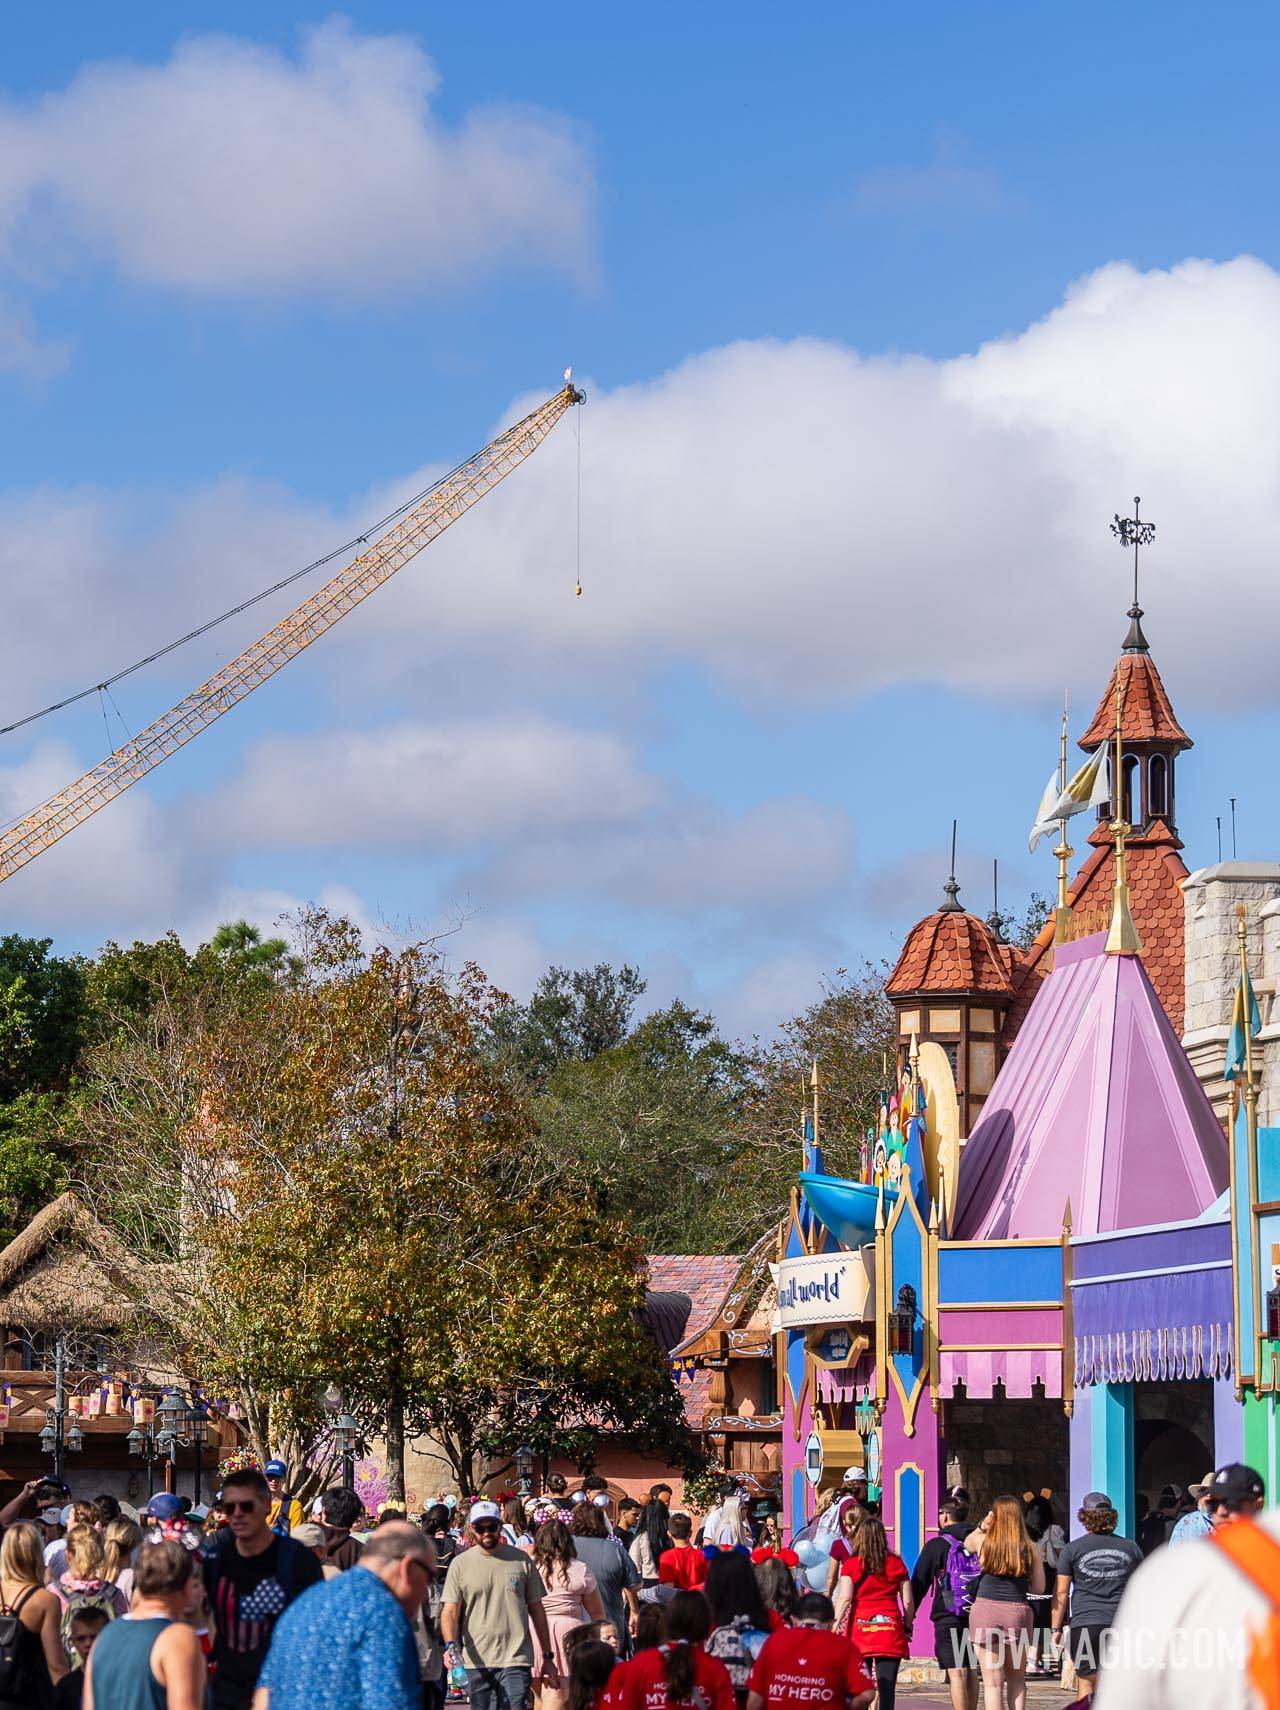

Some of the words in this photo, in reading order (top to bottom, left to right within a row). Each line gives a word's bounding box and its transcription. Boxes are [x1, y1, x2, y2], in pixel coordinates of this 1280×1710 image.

[774, 1673, 826, 1686] HONORING
[646, 1693, 668, 1705] MY
[768, 1684, 786, 1697] MY
[788, 1687, 834, 1701] HERO
